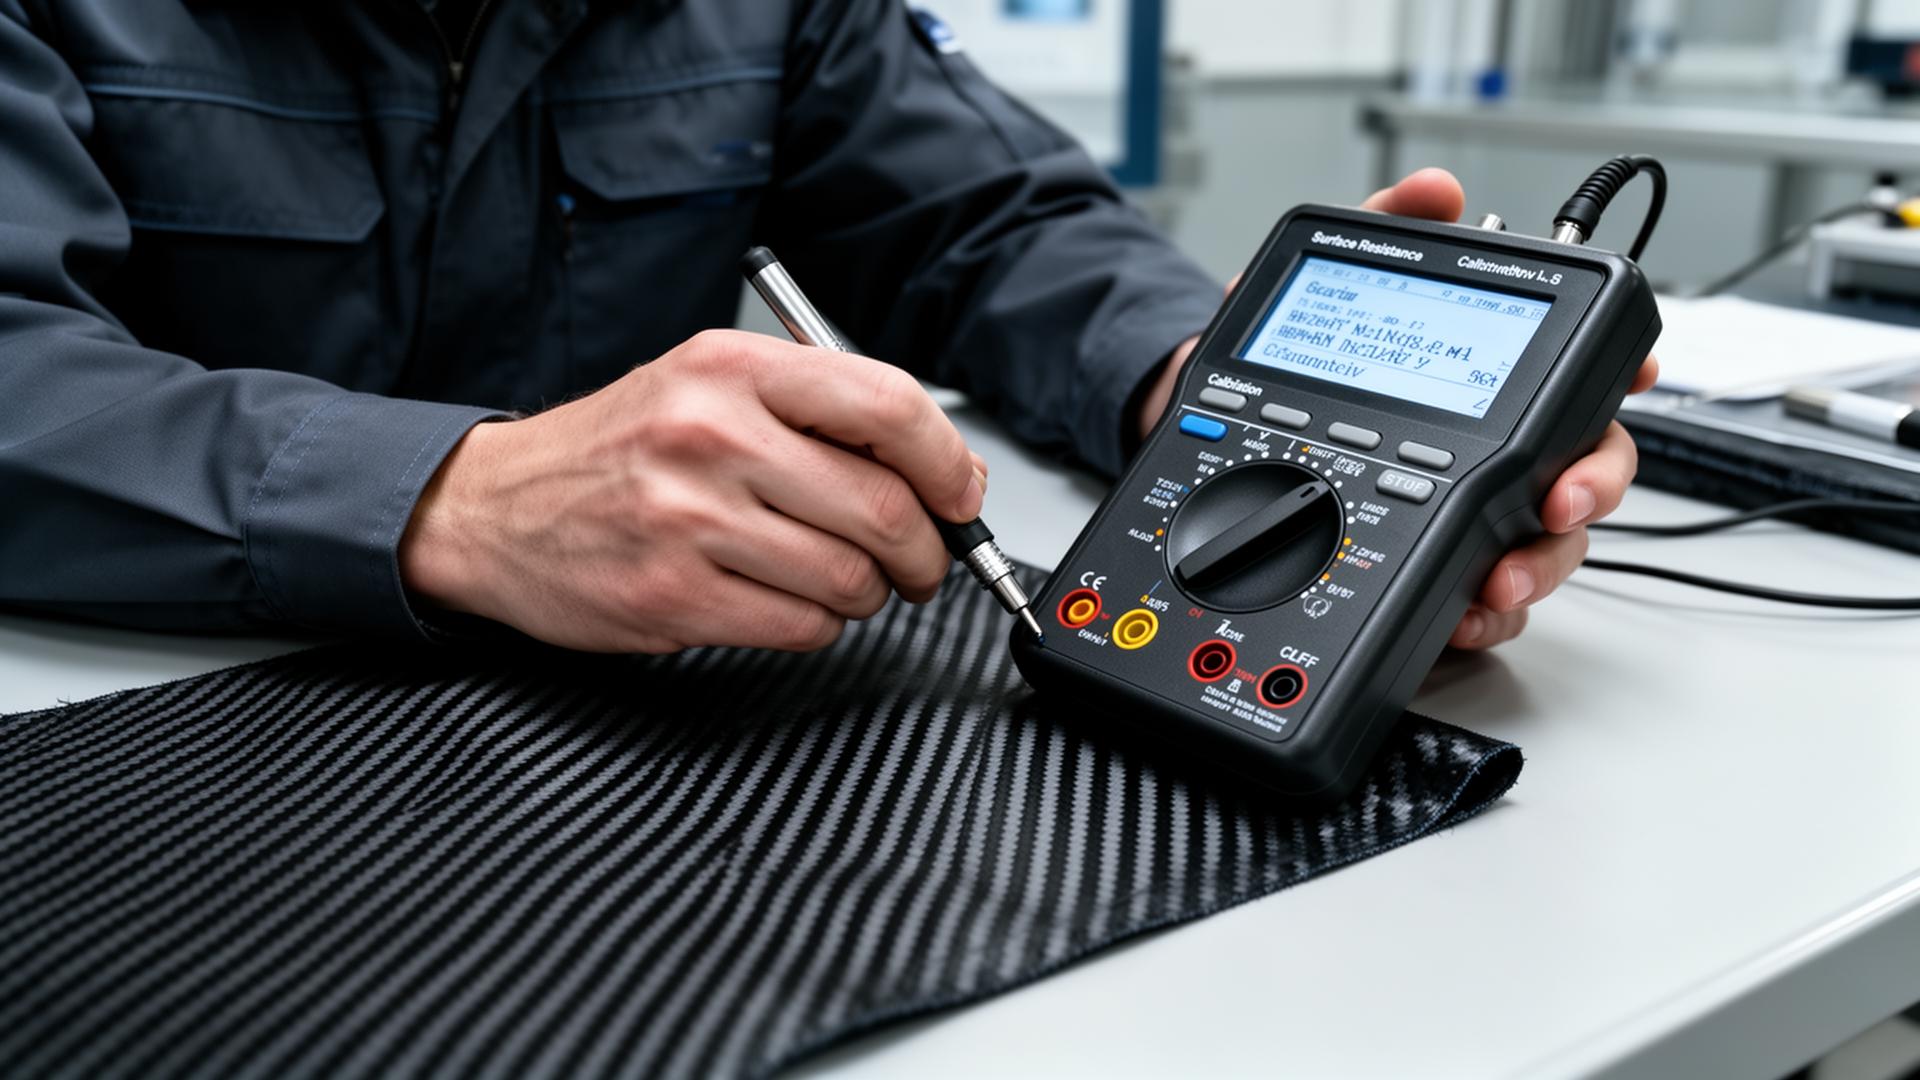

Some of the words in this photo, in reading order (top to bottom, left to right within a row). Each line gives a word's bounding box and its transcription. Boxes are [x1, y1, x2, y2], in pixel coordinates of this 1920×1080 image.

[1311, 231, 1358, 249] Surface
[1357, 239, 1424, 262] Resistance
[1384, 472, 1426, 493] STUF
